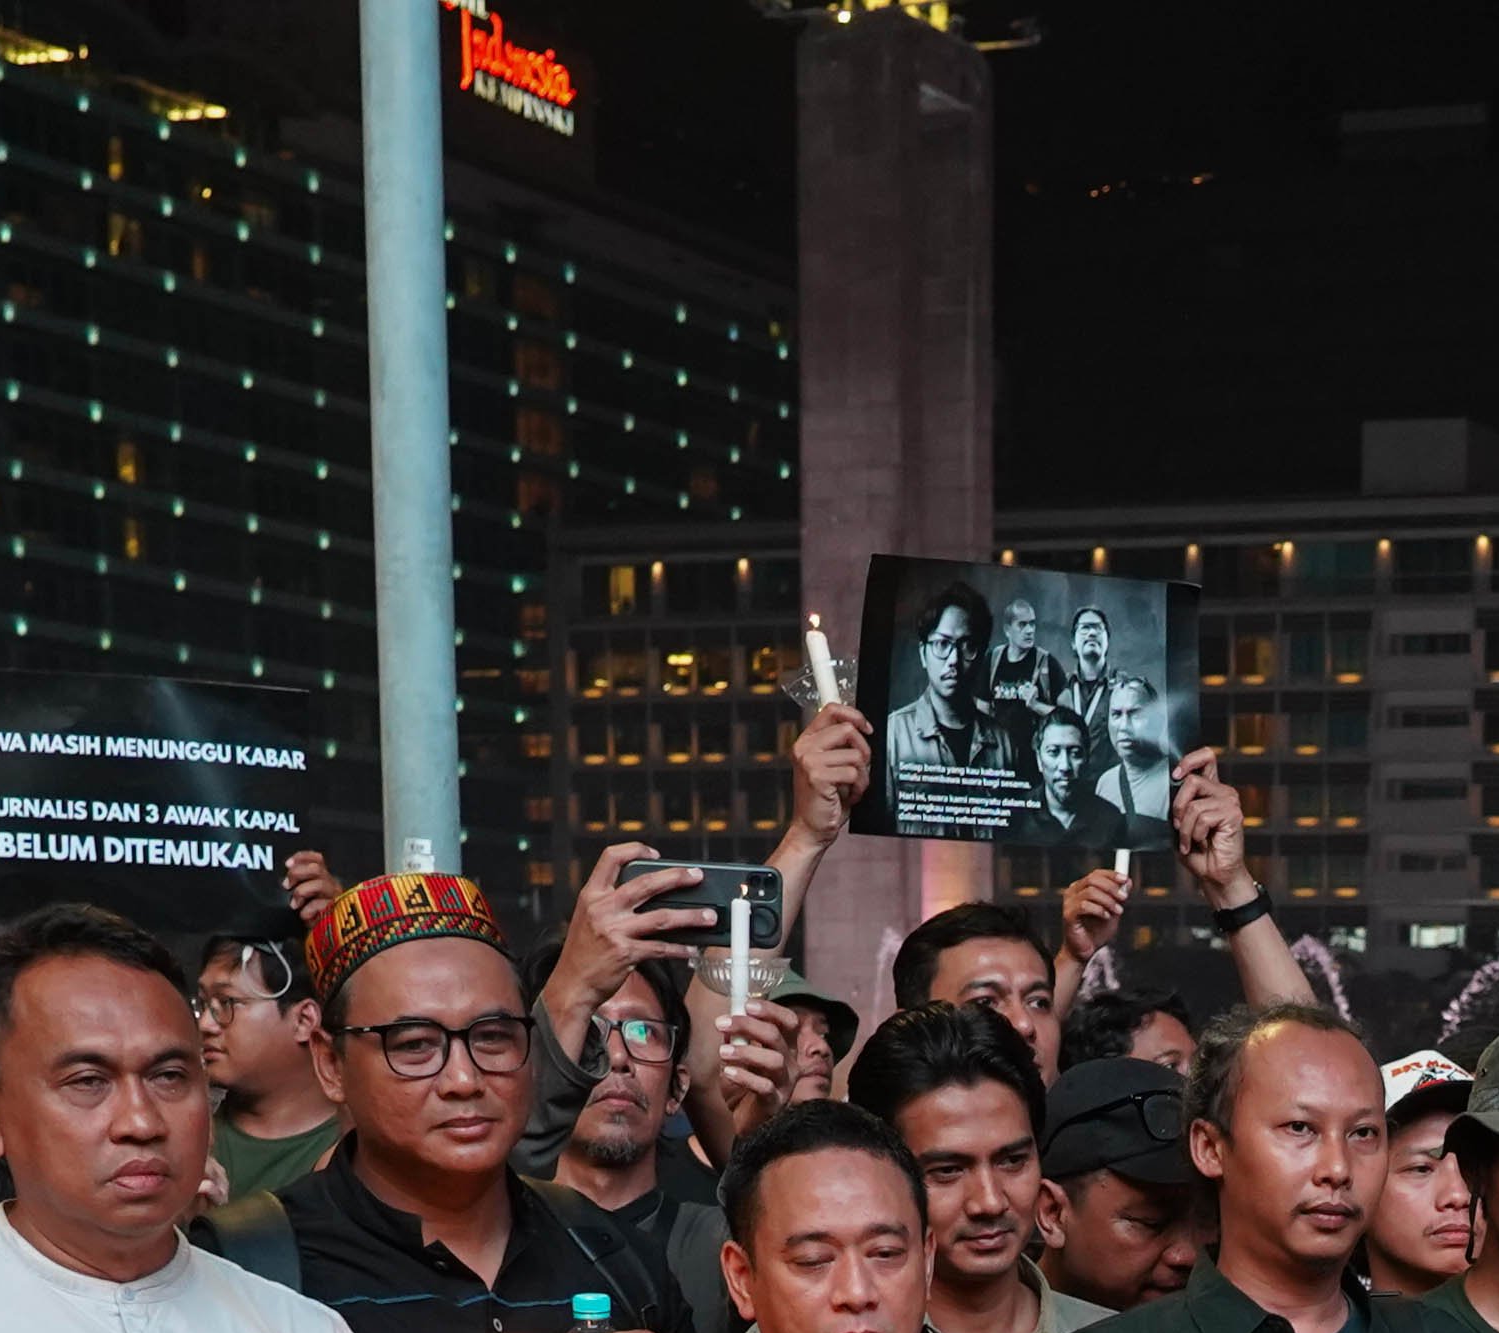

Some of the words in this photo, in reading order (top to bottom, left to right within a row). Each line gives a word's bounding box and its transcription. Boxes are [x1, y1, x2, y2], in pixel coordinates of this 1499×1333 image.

[29, 733, 101, 757] MASIH
[105, 736, 232, 764] MENUNGGU
[236, 744, 307, 771] KABAR
[92, 801, 140, 824] DAN
[145, 804, 160, 825] 3
[163, 805, 230, 830] AWAK
[234, 809, 301, 834] KAPAL
[103, 836, 274, 871] DITEMUKAN
